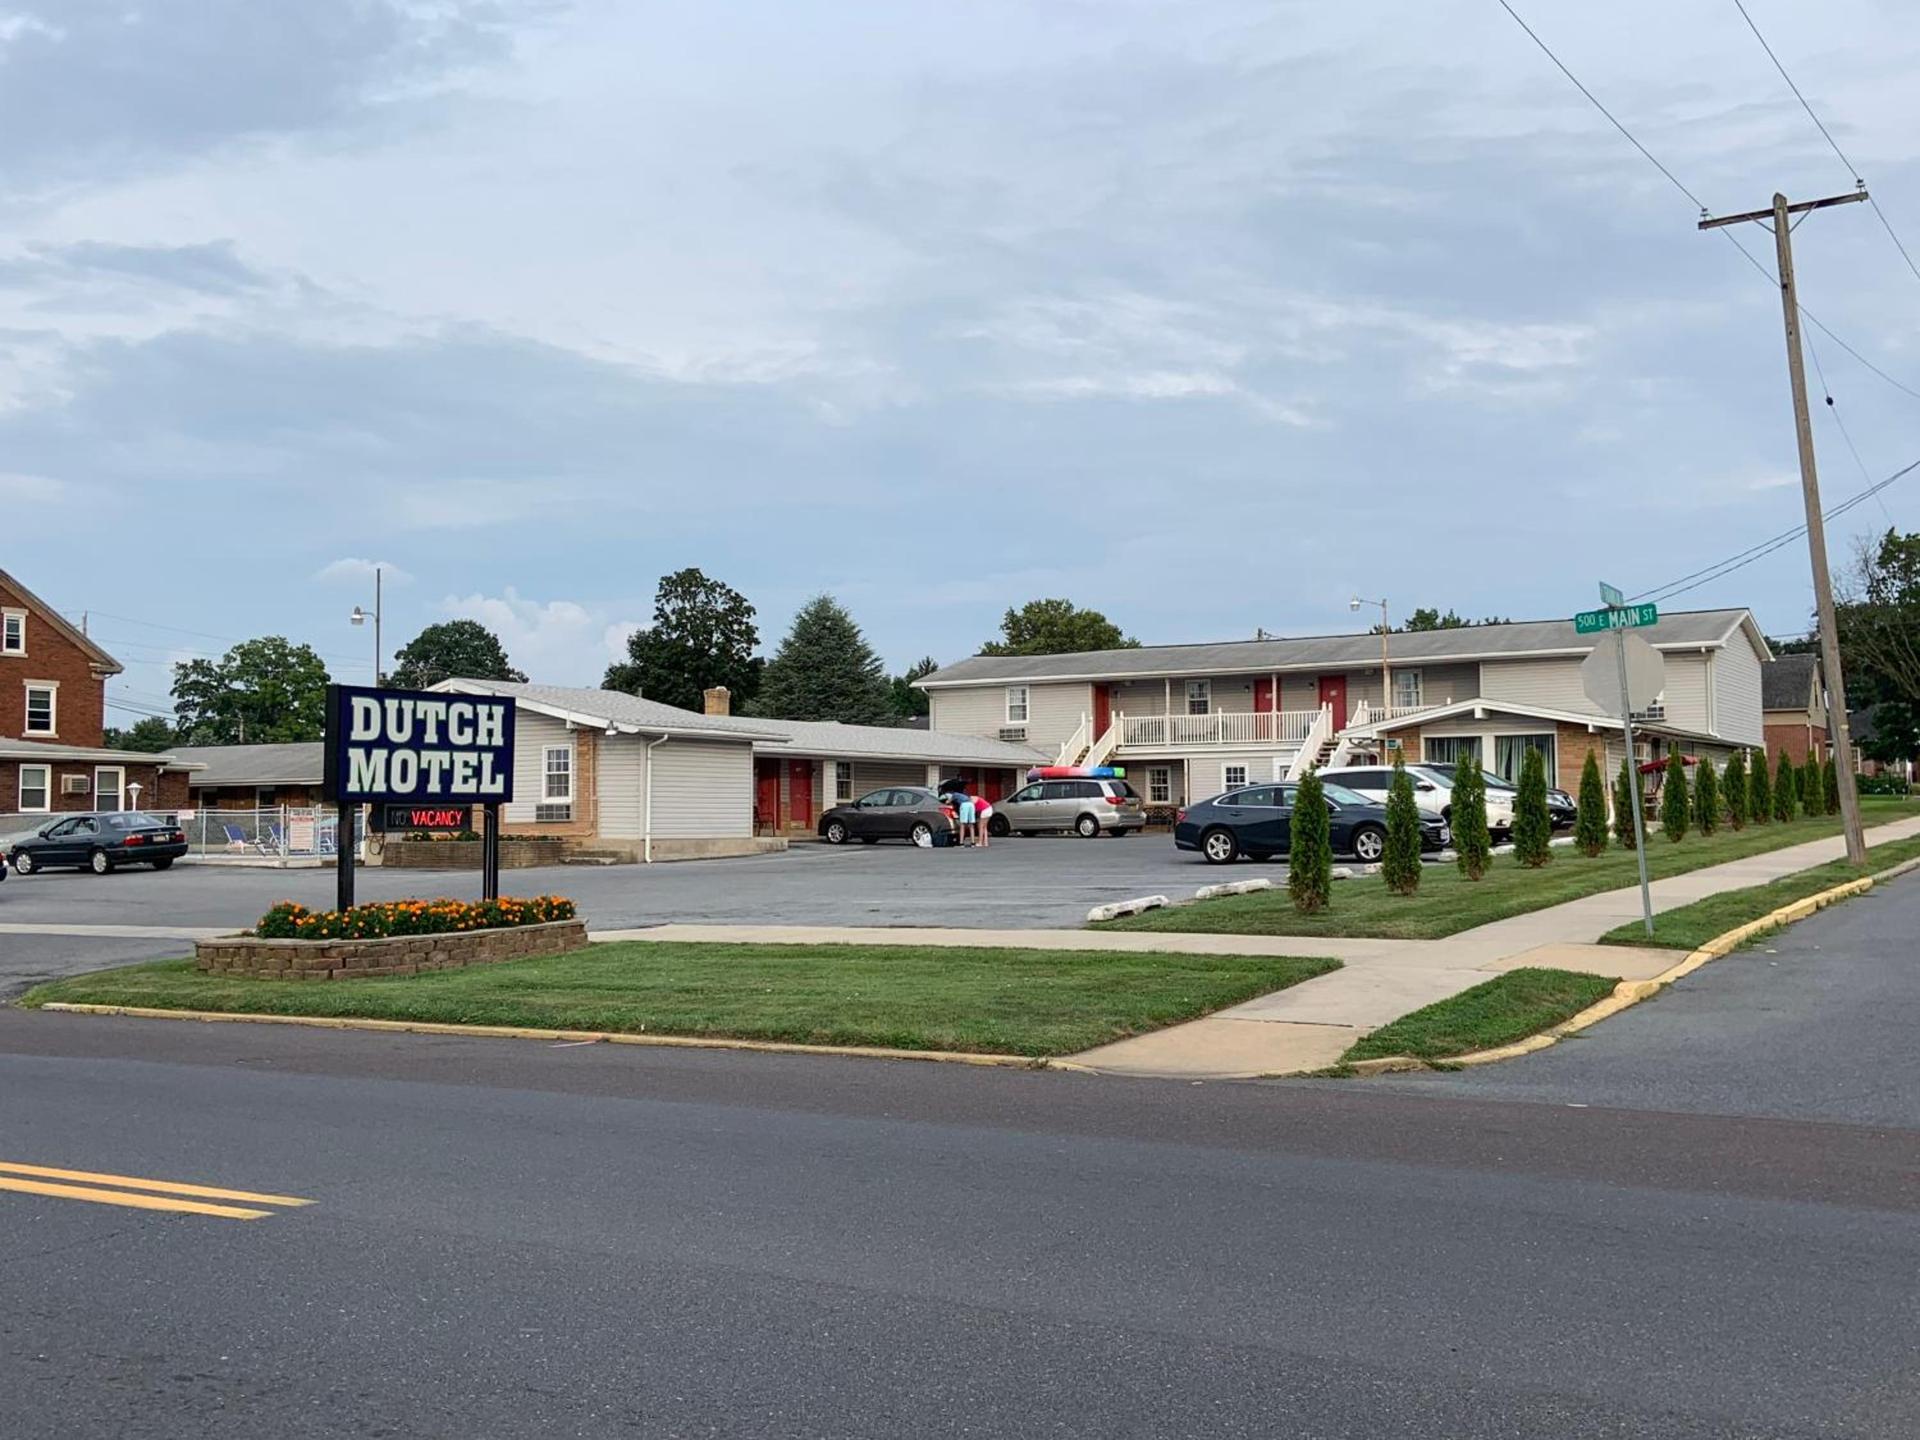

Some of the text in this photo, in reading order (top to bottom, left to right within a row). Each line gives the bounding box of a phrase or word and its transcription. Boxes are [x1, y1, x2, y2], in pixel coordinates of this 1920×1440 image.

[1577, 608, 1653, 628] 500 E MAIN ST
[350, 696, 504, 747] DUTCH
[347, 748, 505, 794] MOTEL
[411, 810, 463, 827] VACANCY
